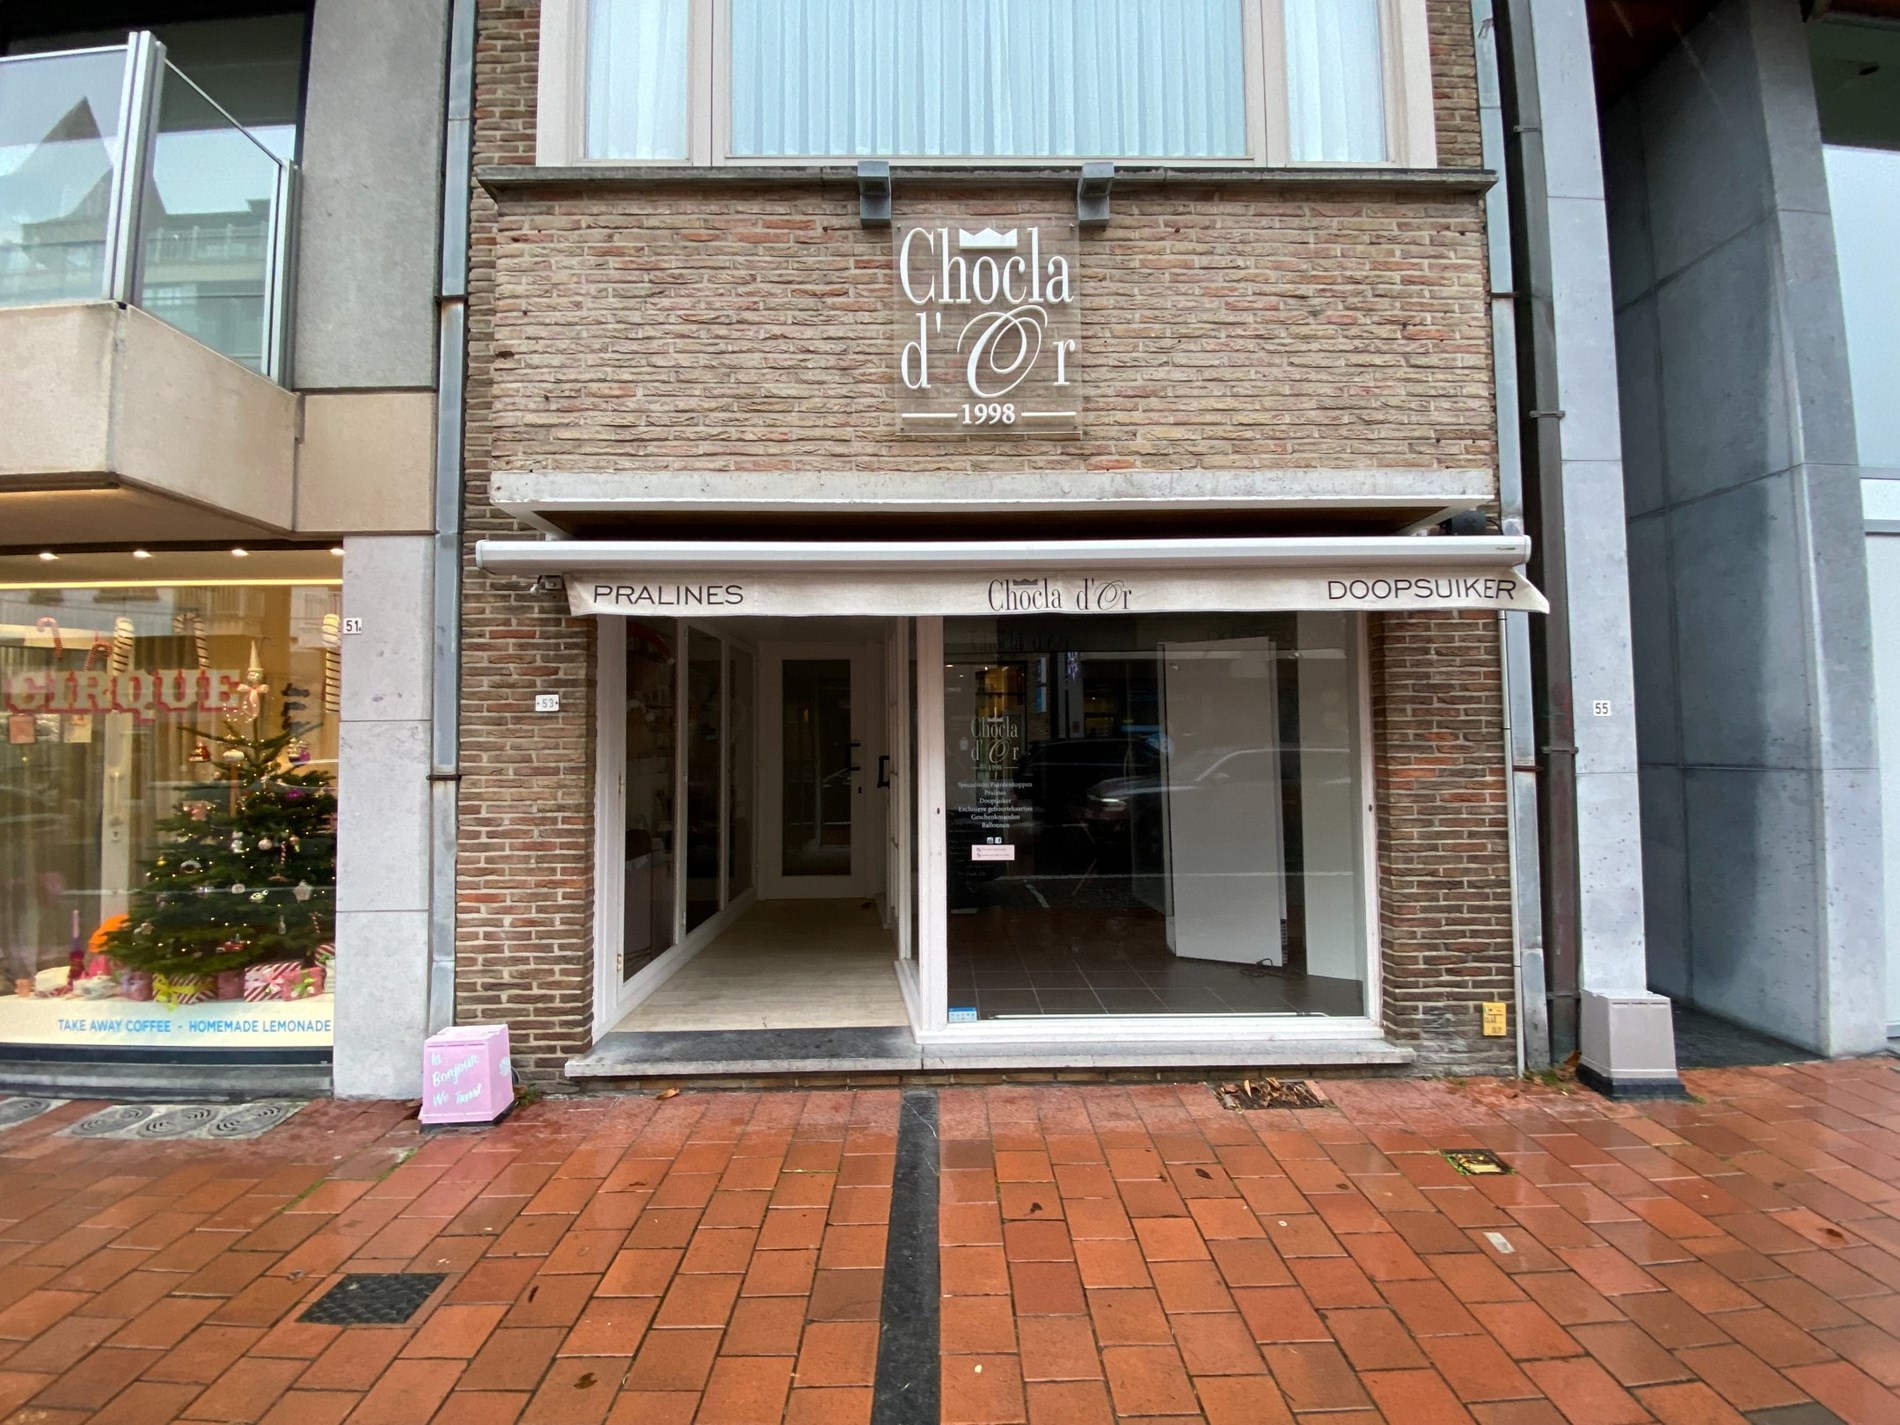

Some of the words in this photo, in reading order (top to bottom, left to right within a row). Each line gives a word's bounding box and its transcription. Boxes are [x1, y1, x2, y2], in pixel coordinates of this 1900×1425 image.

[900, 226, 1075, 306] Chocla
[961, 403, 1016, 425] 1998
[593, 584, 744, 605] PRALINES
[988, 578, 1062, 612] Chocla
[1076, 578, 1132, 611] d'Or
[1327, 578, 1517, 600] DOOPSUIKER
[4, 668, 241, 723] CIRQUE
[541, 698, 554, 709] 53
[1595, 702, 1609, 715] 55
[971, 715, 1018, 738] Chocla
[58, 1019, 86, 1031] TAKE
[89, 1020, 122, 1032] AWAY
[125, 1020, 171, 1032] COFFEE
[189, 1020, 259, 1032] HOMEMADE
[262, 1020, 332, 1032] LEMONADE
[433, 1092, 448, 1106] We
